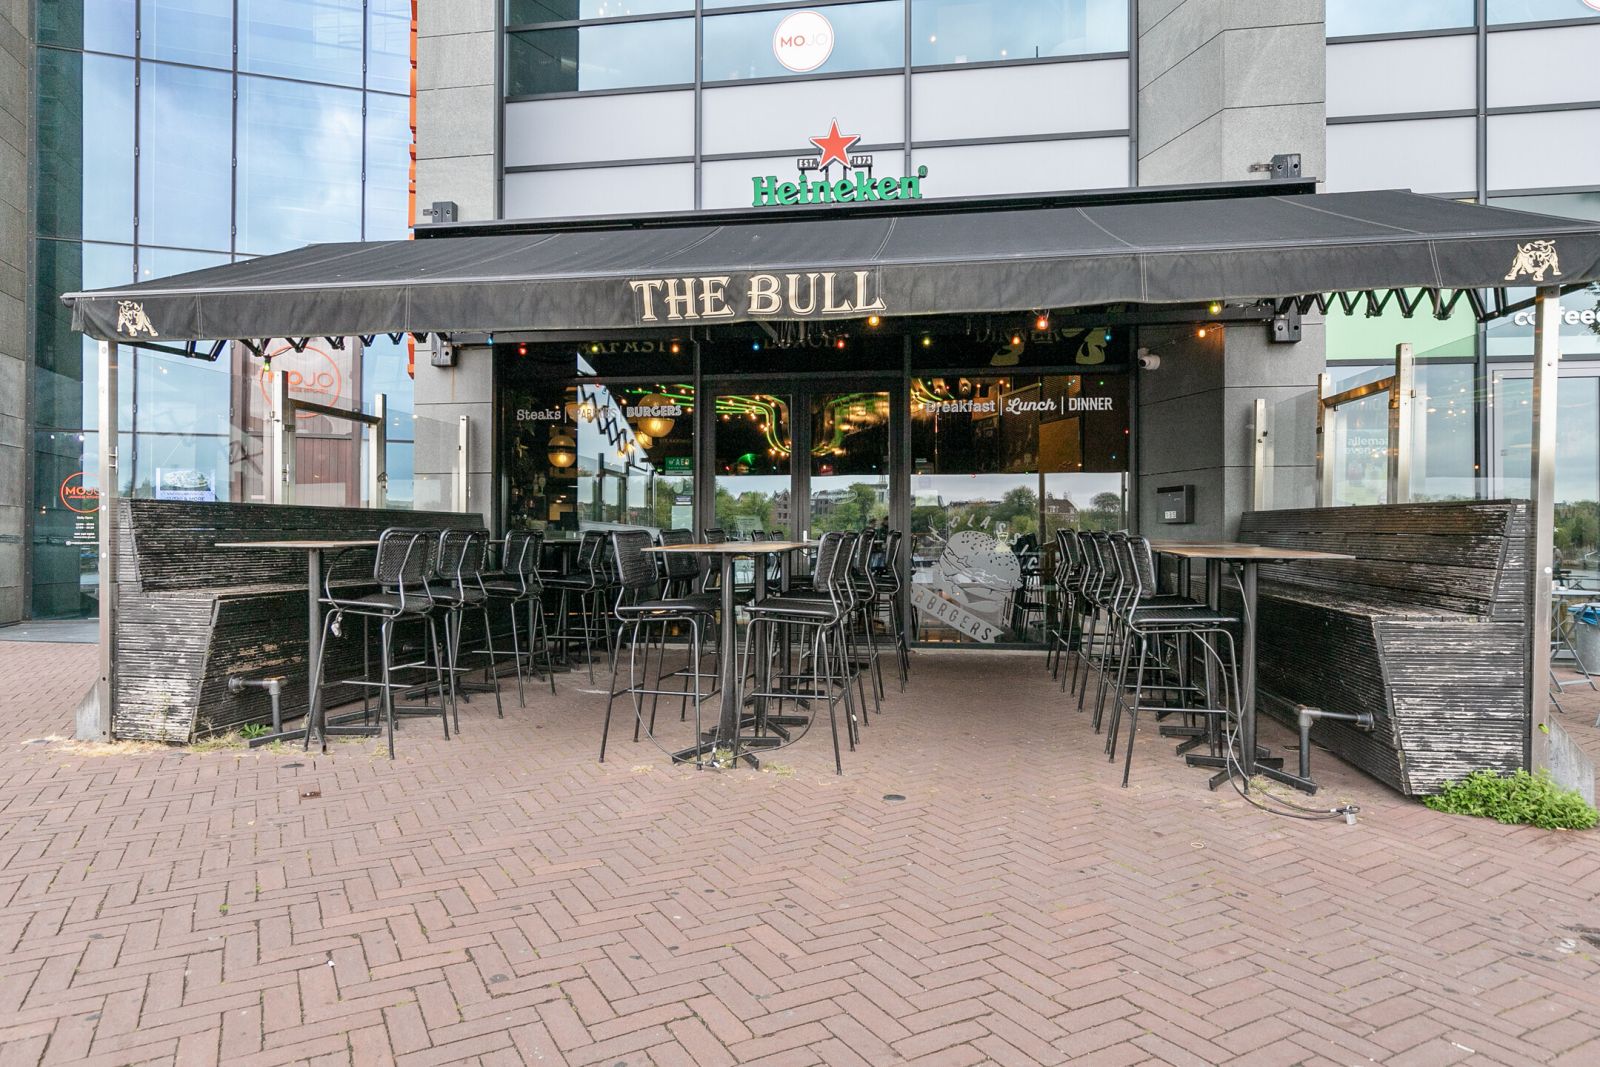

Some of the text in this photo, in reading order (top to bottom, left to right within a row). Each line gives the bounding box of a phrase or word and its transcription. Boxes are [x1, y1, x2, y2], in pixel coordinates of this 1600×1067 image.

[781, 33, 827, 47] MOJO
[799, 156, 872, 168] EST. 1873
[752, 171, 922, 207] Heineken
[629, 271, 887, 321] THE BULL
[516, 408, 561, 421] Steaks
[626, 405, 682, 418] BURGERS
[926, 397, 1113, 415] Breakfast Lunch DINNER
